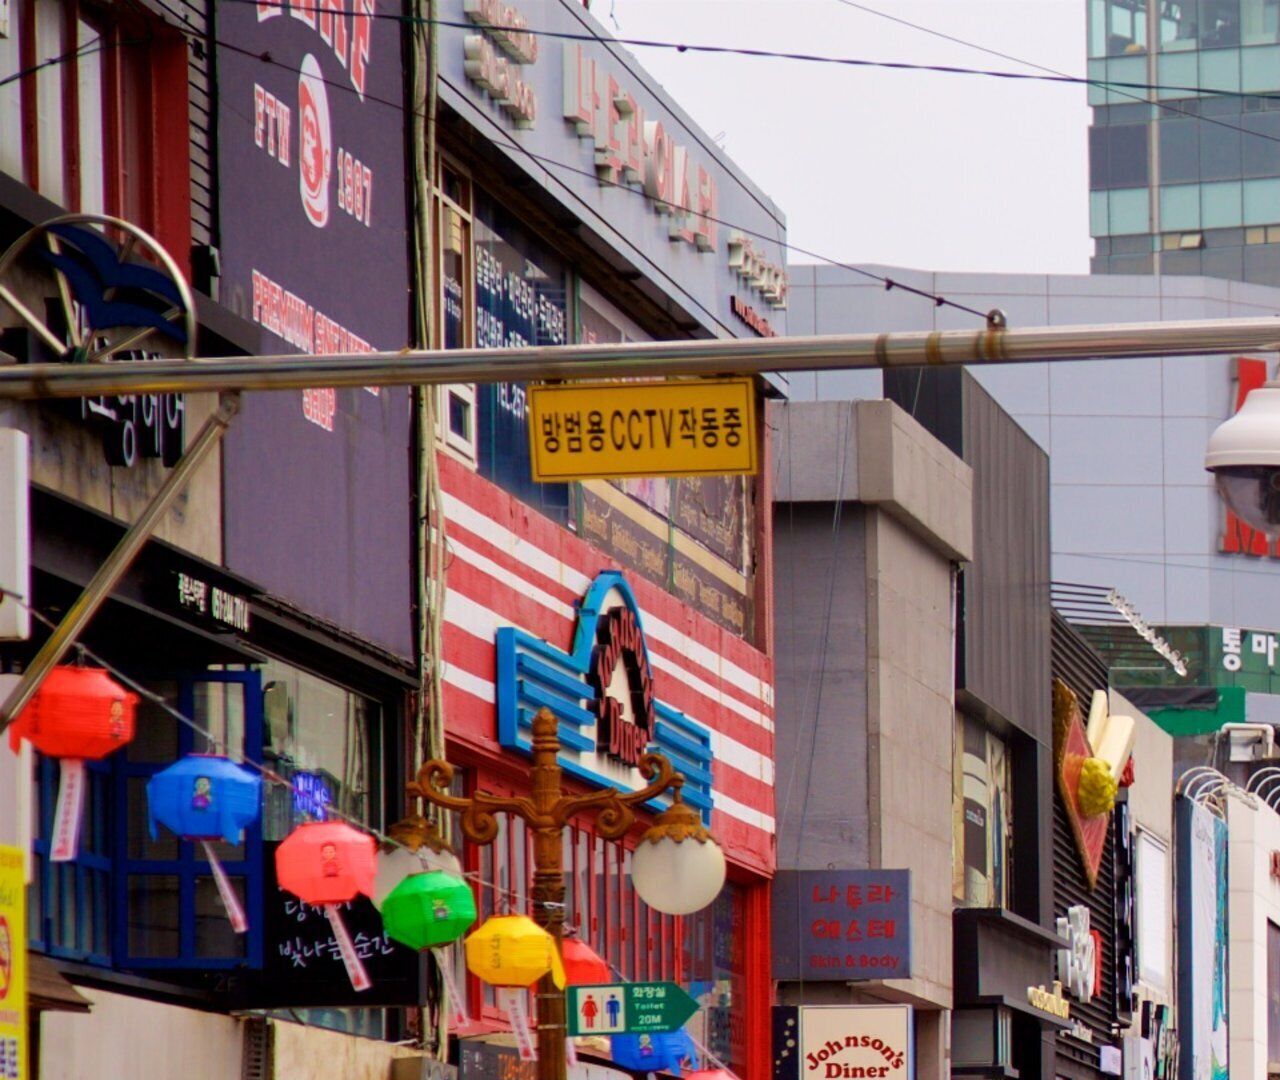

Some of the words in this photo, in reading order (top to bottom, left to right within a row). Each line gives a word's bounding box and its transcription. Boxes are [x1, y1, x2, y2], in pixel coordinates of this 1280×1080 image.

[541, 405, 742, 454] 방범용CCTV작동중
[812, 885, 896, 911] 나투라
[811, 919, 896, 942] 에스테
[809, 955, 842, 968] Skin
[845, 955, 856, 968] &
[859, 955, 899, 972] Body
[632, 986, 667, 998] 화장실
[638, 1015, 662, 1025] 20M
[806, 1035, 904, 1071] Johnson's
[825, 1062, 890, 1080] Diner
